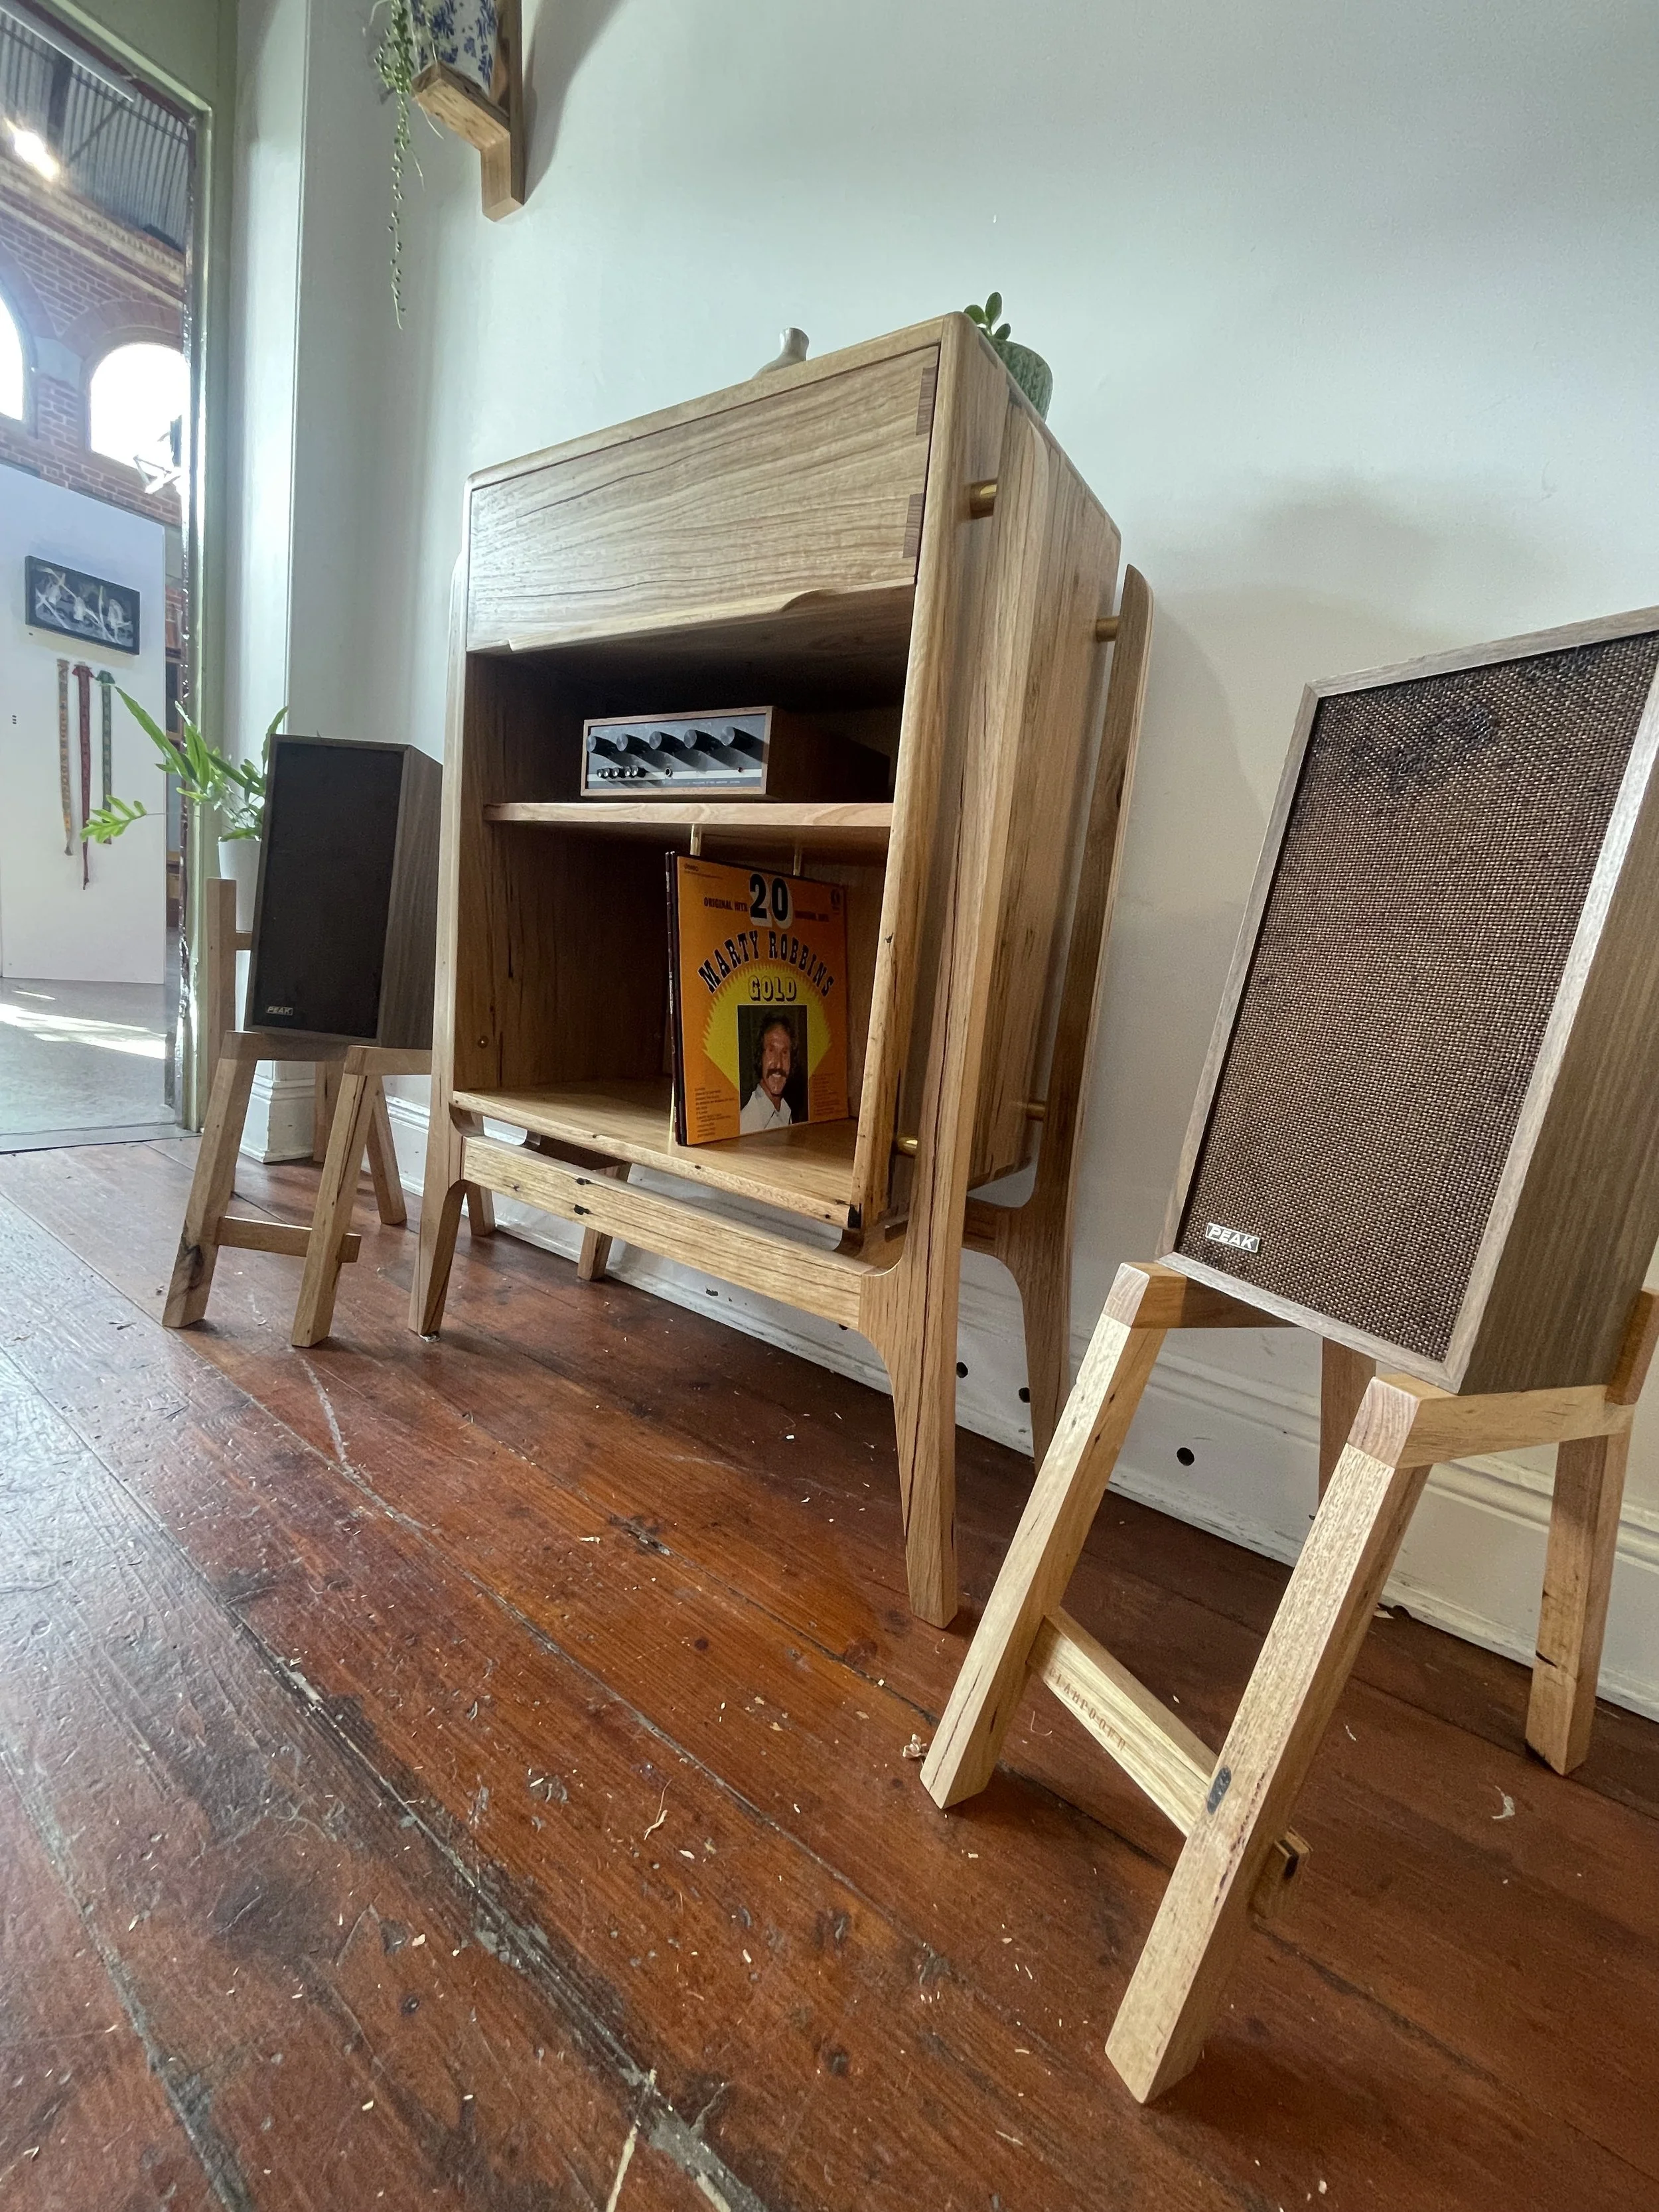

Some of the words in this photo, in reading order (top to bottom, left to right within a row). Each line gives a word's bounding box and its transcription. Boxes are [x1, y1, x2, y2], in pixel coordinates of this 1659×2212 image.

[703, 897, 733, 911] ORIGINAL
[734, 901, 748, 913] HITS
[749, 873, 792, 927] 20
[697, 930, 759, 994] MARTY
[768, 930, 835, 997] ROBBINS
[748, 975, 797, 1002] GOLD
[267, 1005, 291, 1015] PEAK
[1208, 1225, 1255, 1249] PEAK
